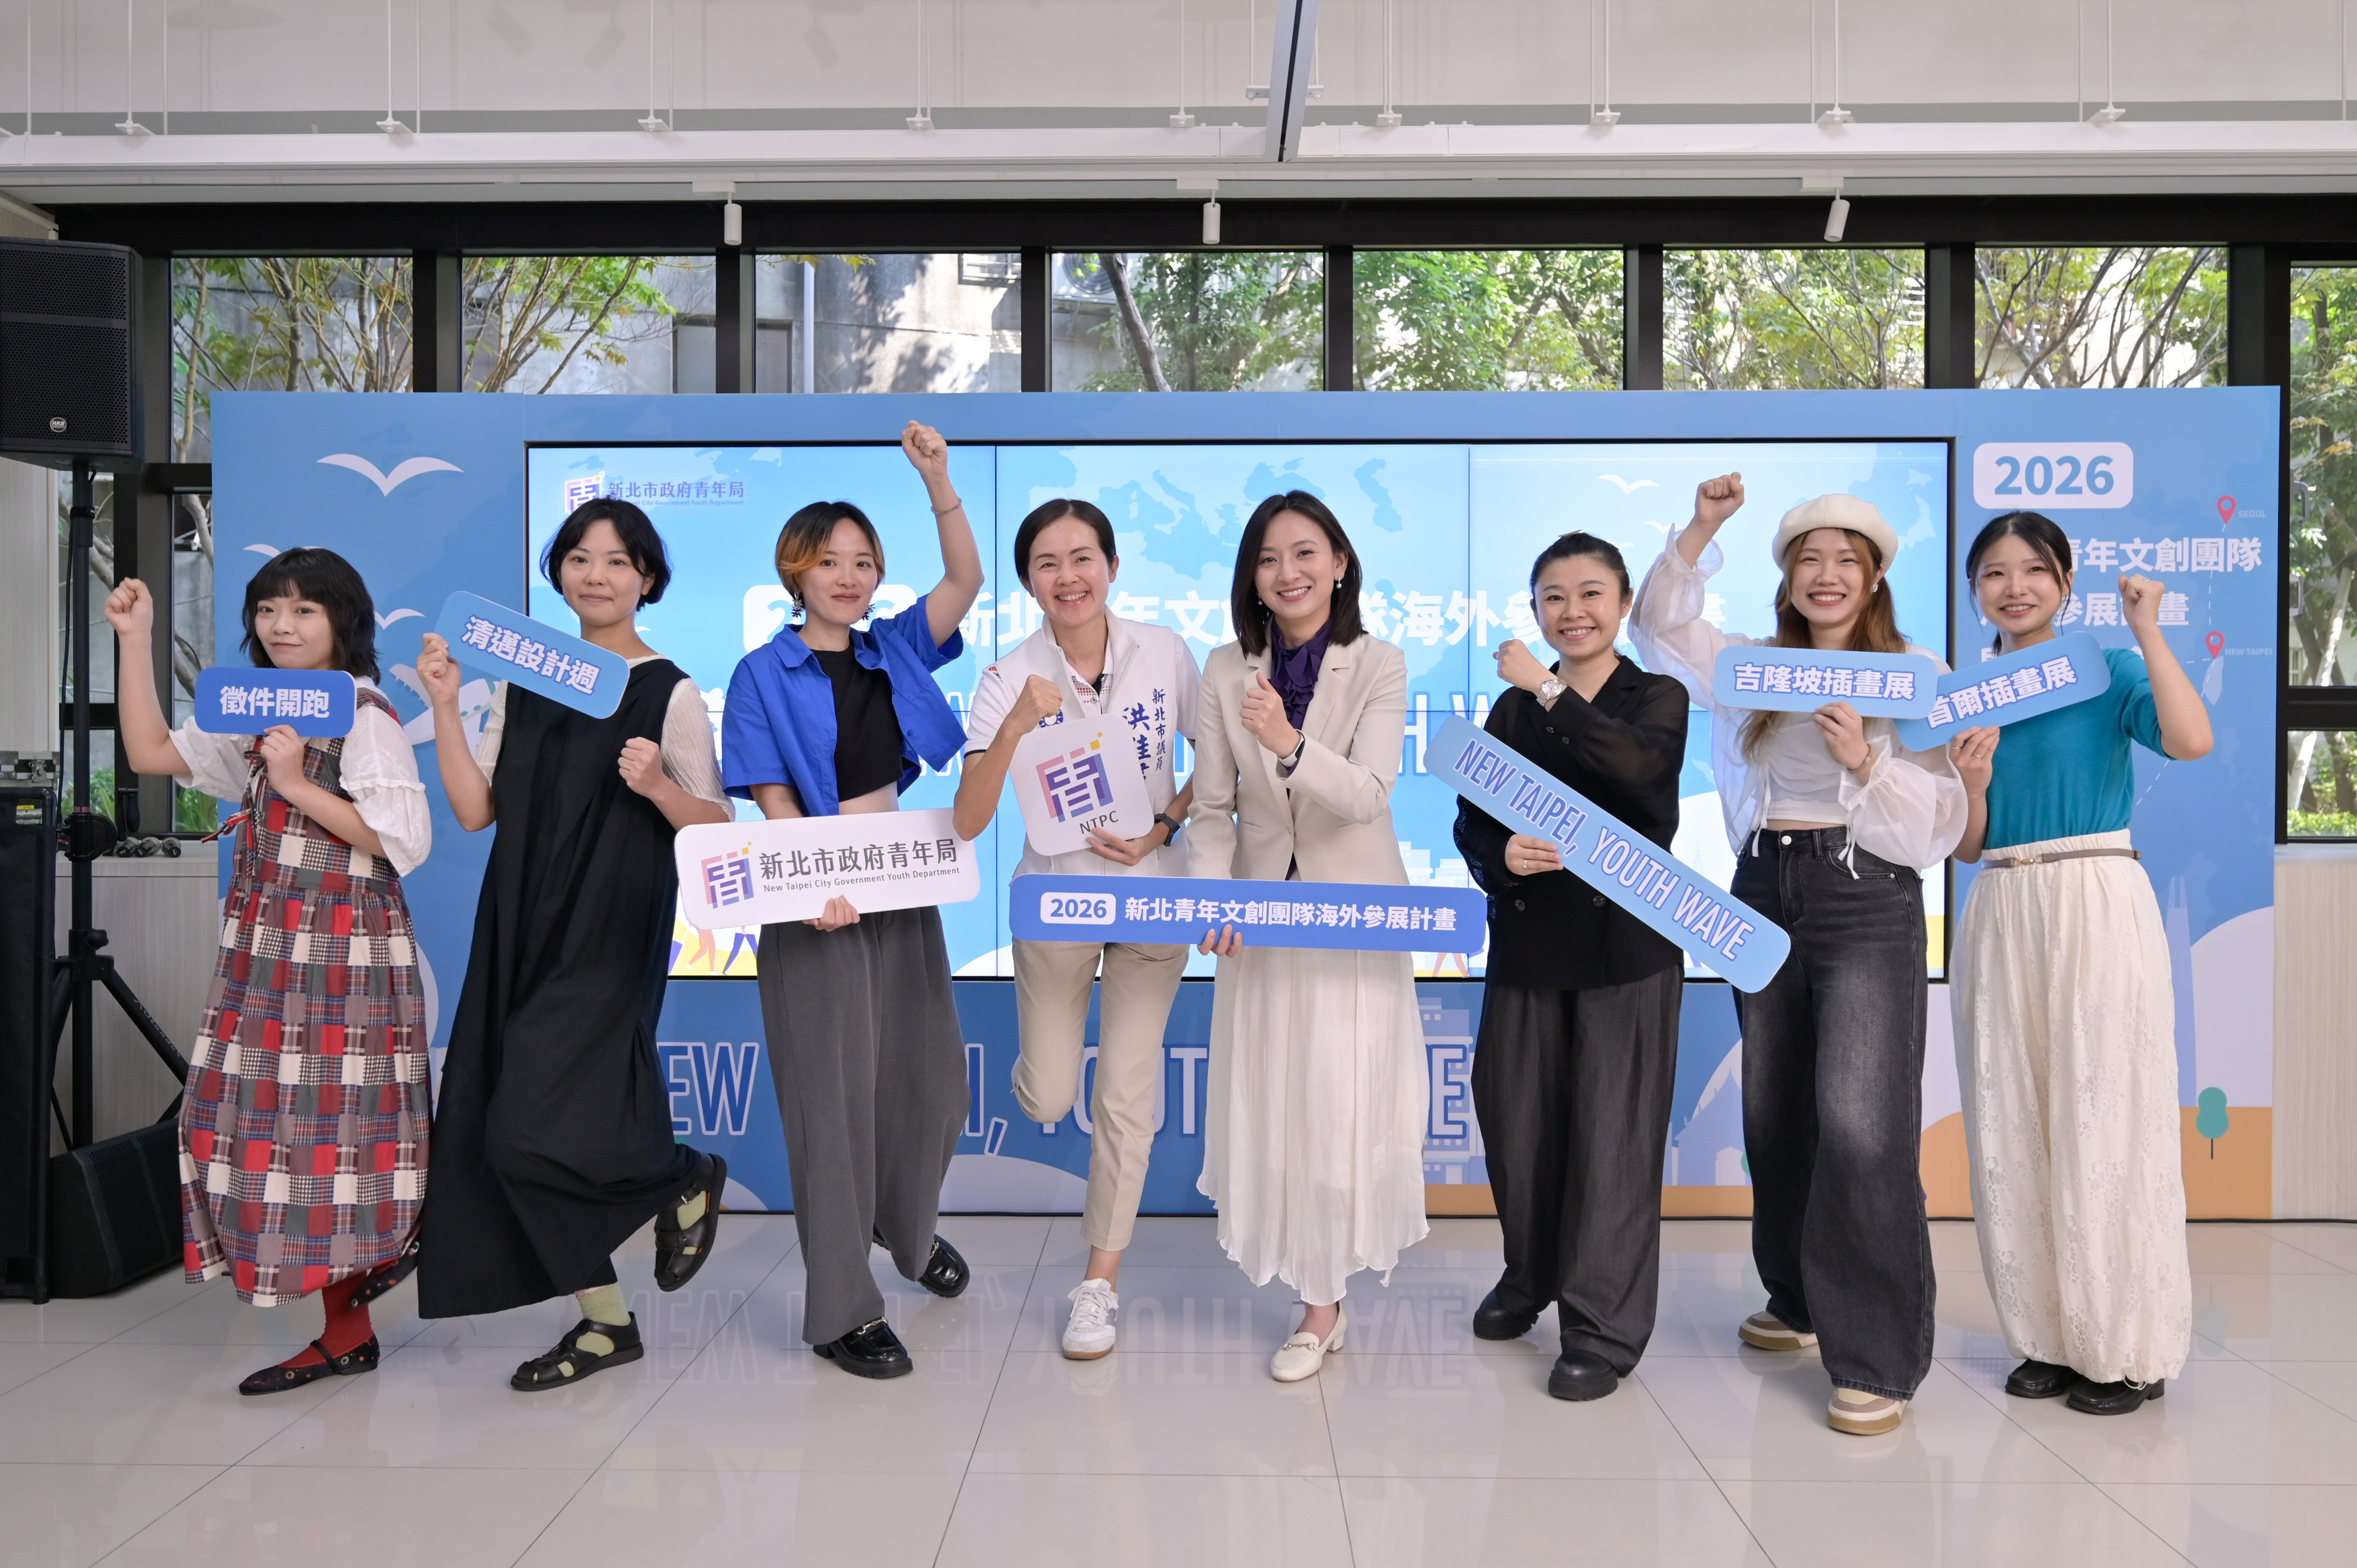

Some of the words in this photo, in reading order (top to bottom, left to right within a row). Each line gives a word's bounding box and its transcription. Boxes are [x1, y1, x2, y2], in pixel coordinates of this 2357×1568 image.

[609, 481, 744, 498] 新北市政府青年局
[1994, 455, 2114, 496] 2026
[460, 614, 601, 696] 清邁設計週
[220, 685, 330, 718] 徵件開跑
[1734, 662, 1916, 701] 吉隆坡插畫展
[1927, 655, 2078, 729] 首爾插畫展
[1152, 688, 1166, 772] 新北市議員
[1080, 811, 1118, 834] NTPC
[759, 839, 957, 880] 新北市政府青年局
[1454, 739, 1518, 797] NEW
[1507, 773, 1588, 857] TAIPEI,
[1587, 826, 1681, 910] YOUTH
[1671, 883, 1755, 962] WAVE
[764, 884, 783, 892] New
[785, 881, 812, 892] Taipei
[815, 879, 831, 888] City
[834, 874, 885, 886] Government
[887, 871, 910, 880] Youth
[913, 867, 960, 879] Department
[1050, 898, 1107, 919] 2026
[1125, 897, 1457, 931] 新北青年文創團隊海外參展計畫
[656, 1042, 760, 1135] EW
